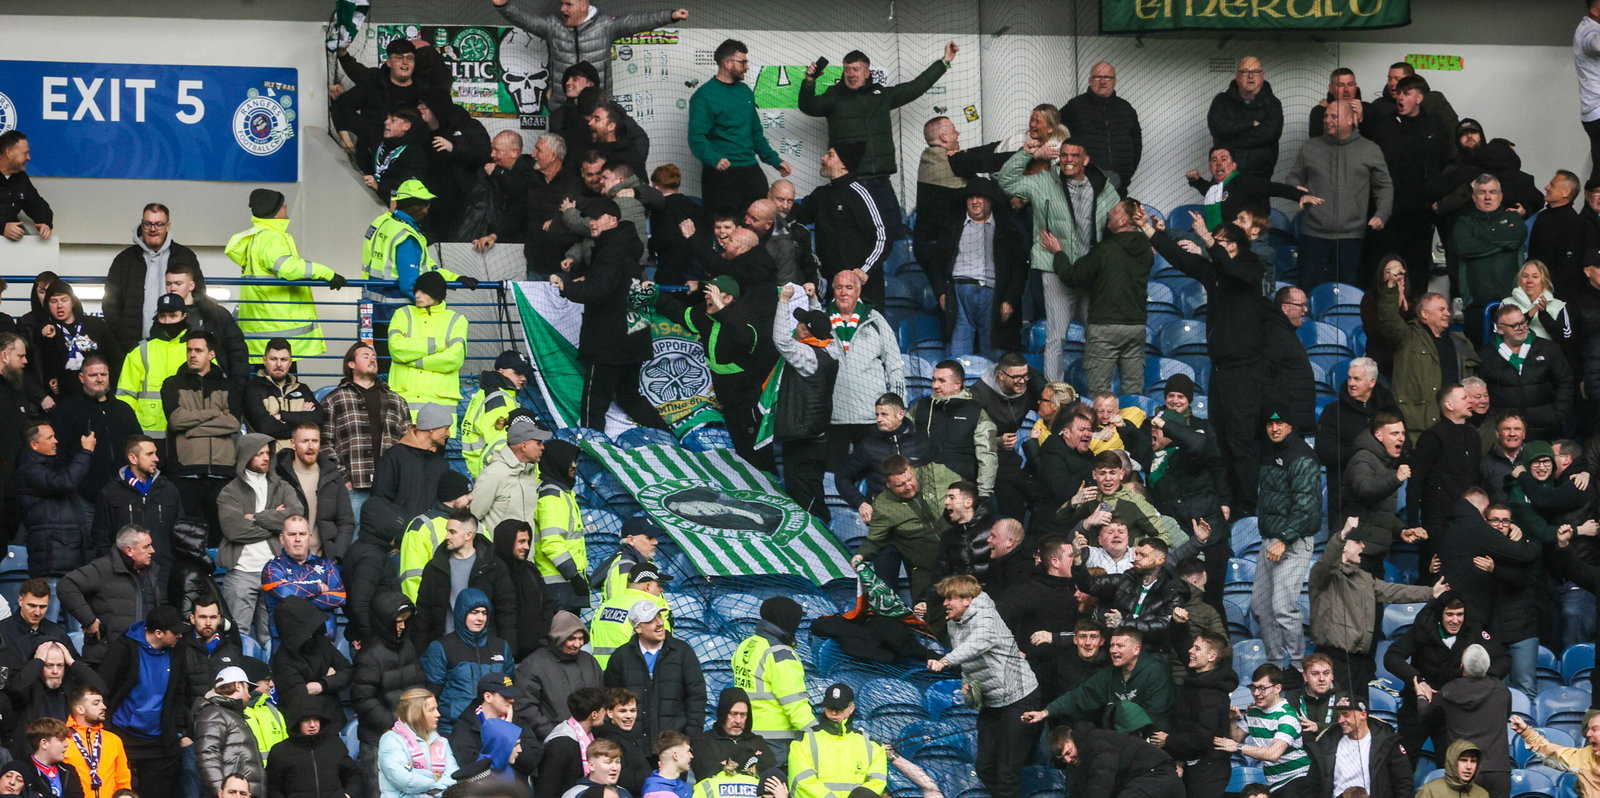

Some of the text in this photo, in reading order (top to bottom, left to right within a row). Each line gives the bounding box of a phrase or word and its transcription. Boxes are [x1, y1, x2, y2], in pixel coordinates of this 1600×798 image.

[43, 76, 205, 125] EXIT 5
[240, 99, 282, 118] RANGERS
[653, 340, 707, 365] UPPORTERS
[601, 608, 627, 622] POLICE
[719, 784, 758, 797] POLICE
